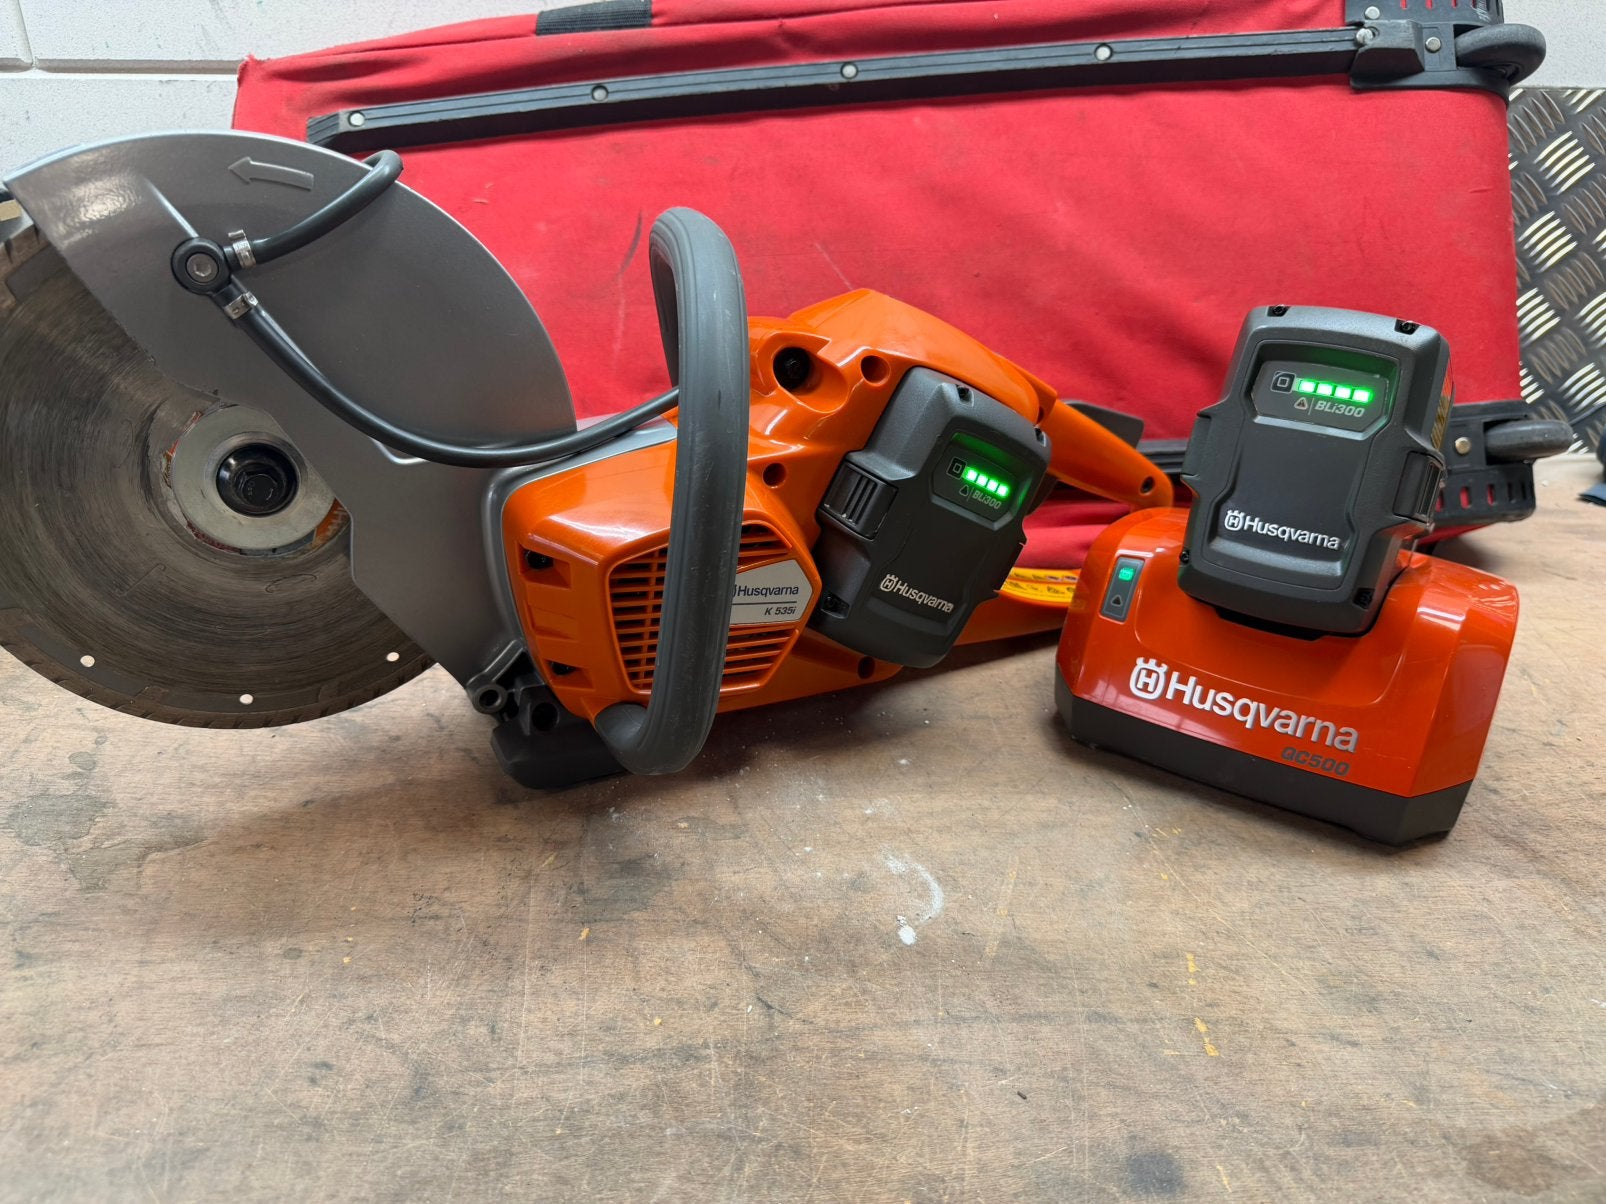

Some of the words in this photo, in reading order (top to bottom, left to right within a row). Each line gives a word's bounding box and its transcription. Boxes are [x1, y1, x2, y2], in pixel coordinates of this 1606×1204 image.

[1314, 400, 1366, 418] BLi300
[972, 490, 1002, 510] BLi300
[1243, 515, 1341, 551] Husqvarna
[737, 584, 799, 597] Husqvarna
[893, 580, 955, 613] Husqvarna
[764, 607, 773, 616] K
[774, 606, 797, 615] 535i
[1165, 671, 1359, 753] Husqvarna
[1280, 746, 1351, 777] QC500
